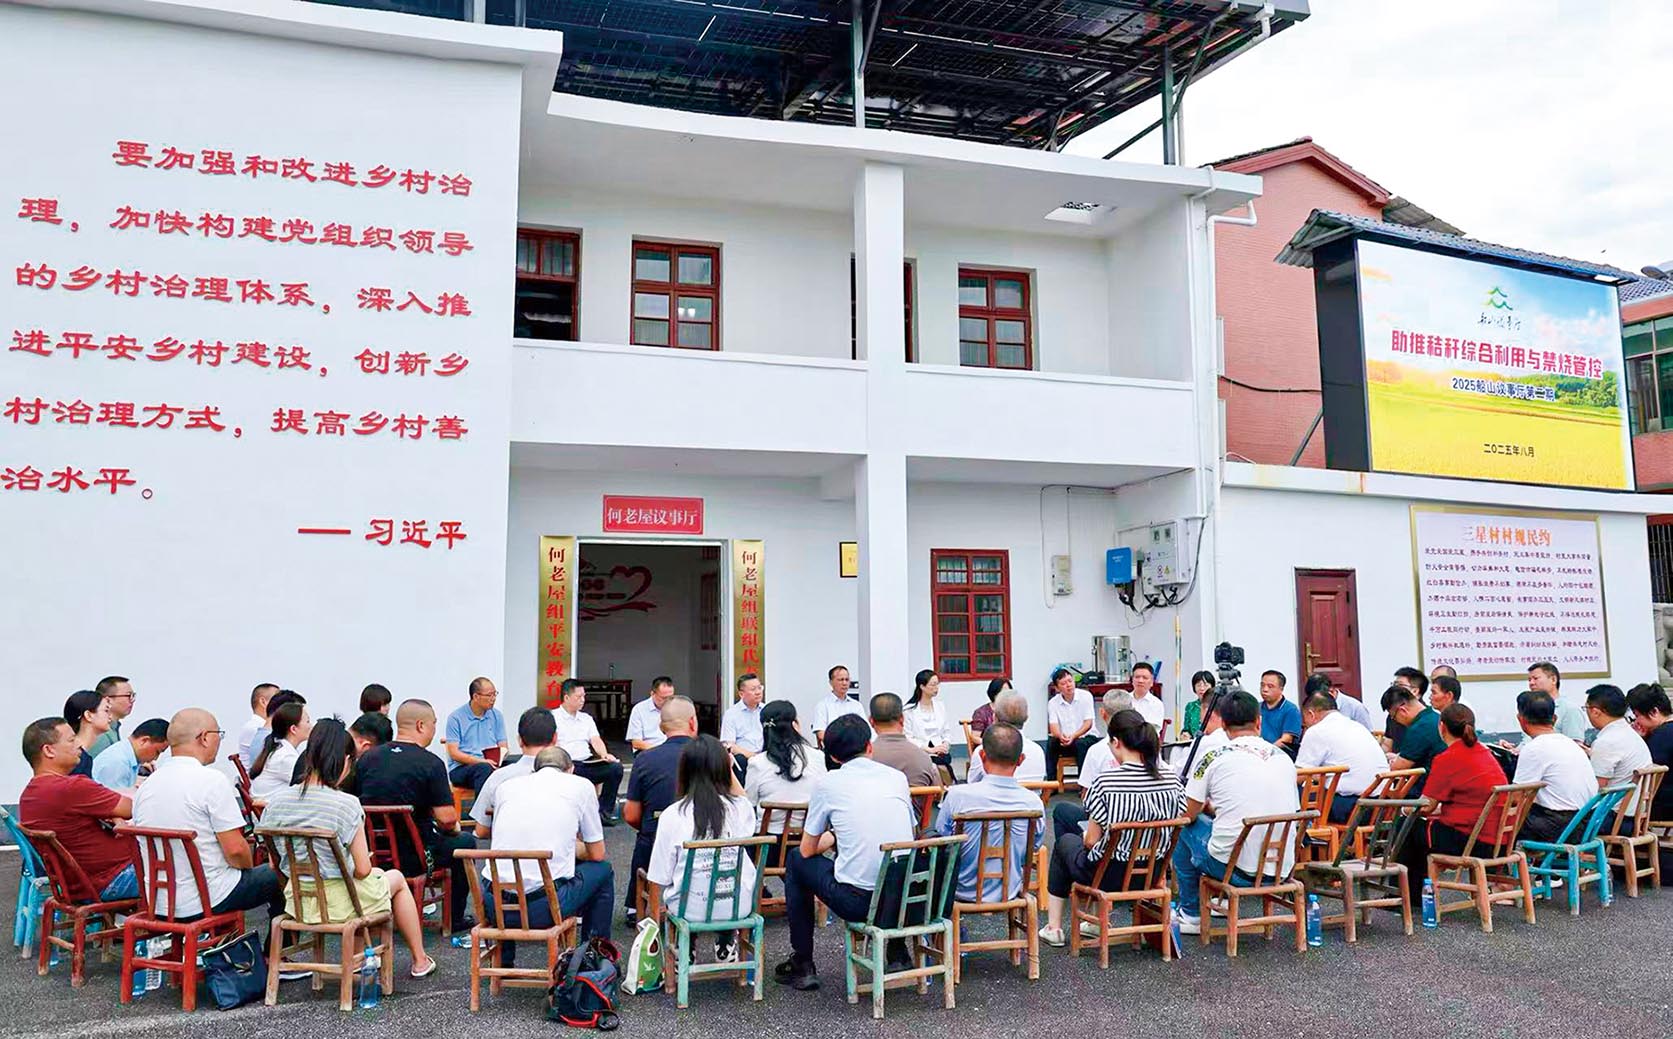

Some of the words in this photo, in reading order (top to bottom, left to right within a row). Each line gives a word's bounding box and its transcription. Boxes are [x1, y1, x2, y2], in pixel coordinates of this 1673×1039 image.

[112, 140, 472, 197] 要加强和改进乡村治
[1391, 329, 1603, 379] 助推秸秆综合利用与禁烧管控
[0, 465, 153, 500] 治水平。
[607, 507, 698, 526] 何老屋议事厅
[1463, 525, 1552, 546] 三星村村规民约
